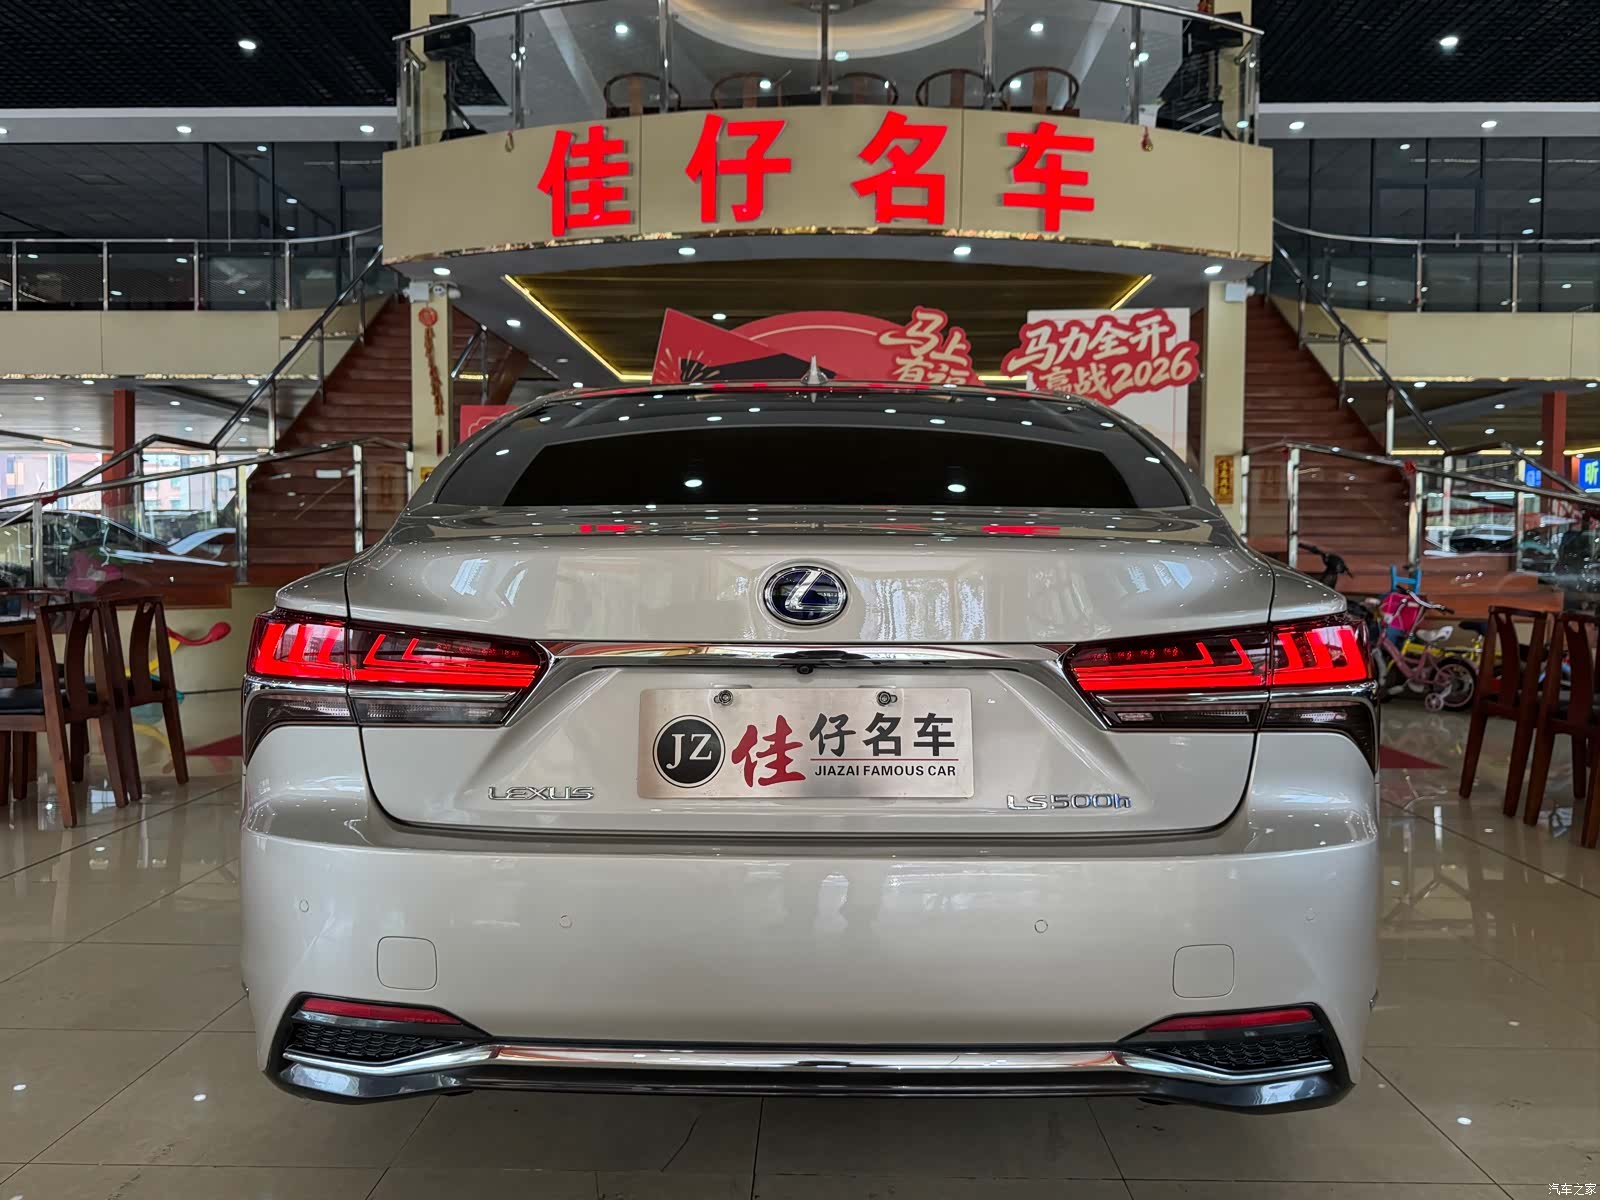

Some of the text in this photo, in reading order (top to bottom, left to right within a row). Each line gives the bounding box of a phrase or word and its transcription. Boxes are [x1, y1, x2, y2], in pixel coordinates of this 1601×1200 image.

[537, 110, 1095, 237] 佳仔名车
[879, 311, 968, 367] 马上
[1007, 315, 1170, 373] 马力全开
[666, 733, 714, 769] JZ
[814, 764, 956, 777] JIAZAI FAMOUS CAR
[488, 786, 594, 801] LEXUS
